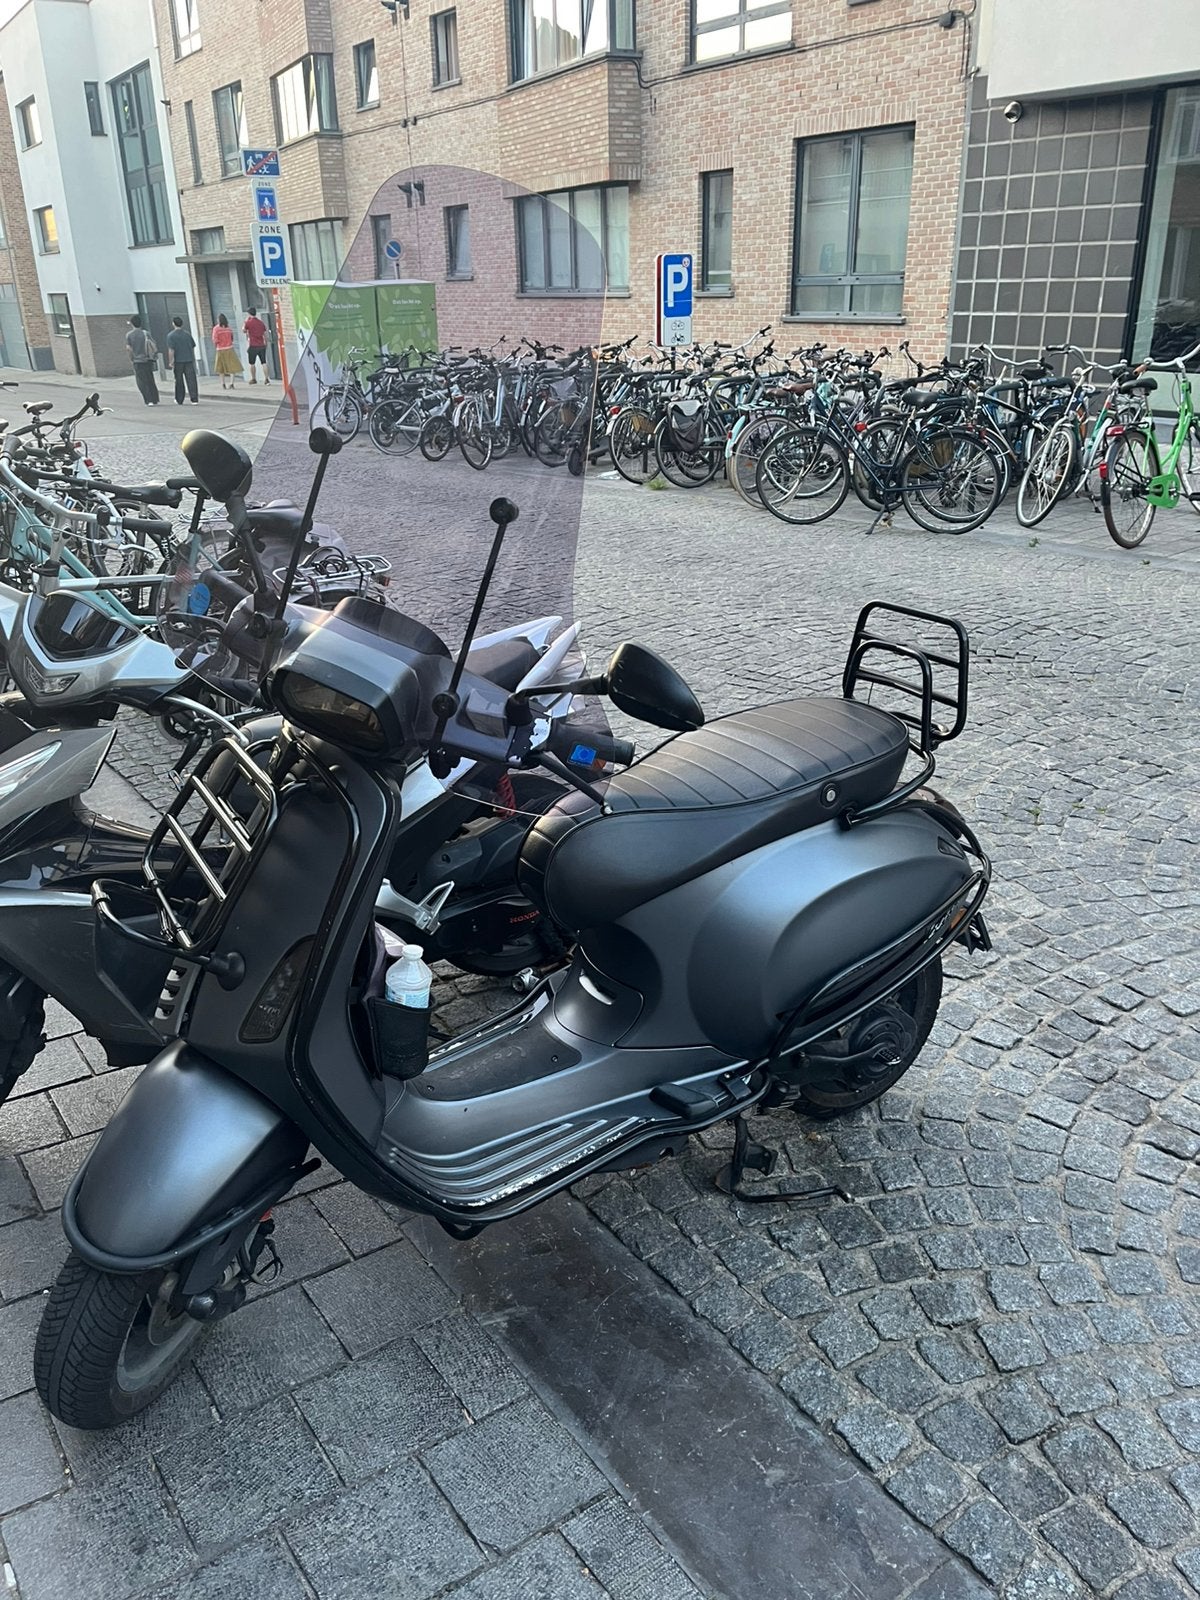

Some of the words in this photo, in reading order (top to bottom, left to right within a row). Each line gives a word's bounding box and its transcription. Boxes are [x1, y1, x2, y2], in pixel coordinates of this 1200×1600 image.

[259, 225, 281, 234] ZONE
[262, 241, 282, 269] P
[667, 263, 689, 308] P
[510, 910, 540, 923] HONDA
